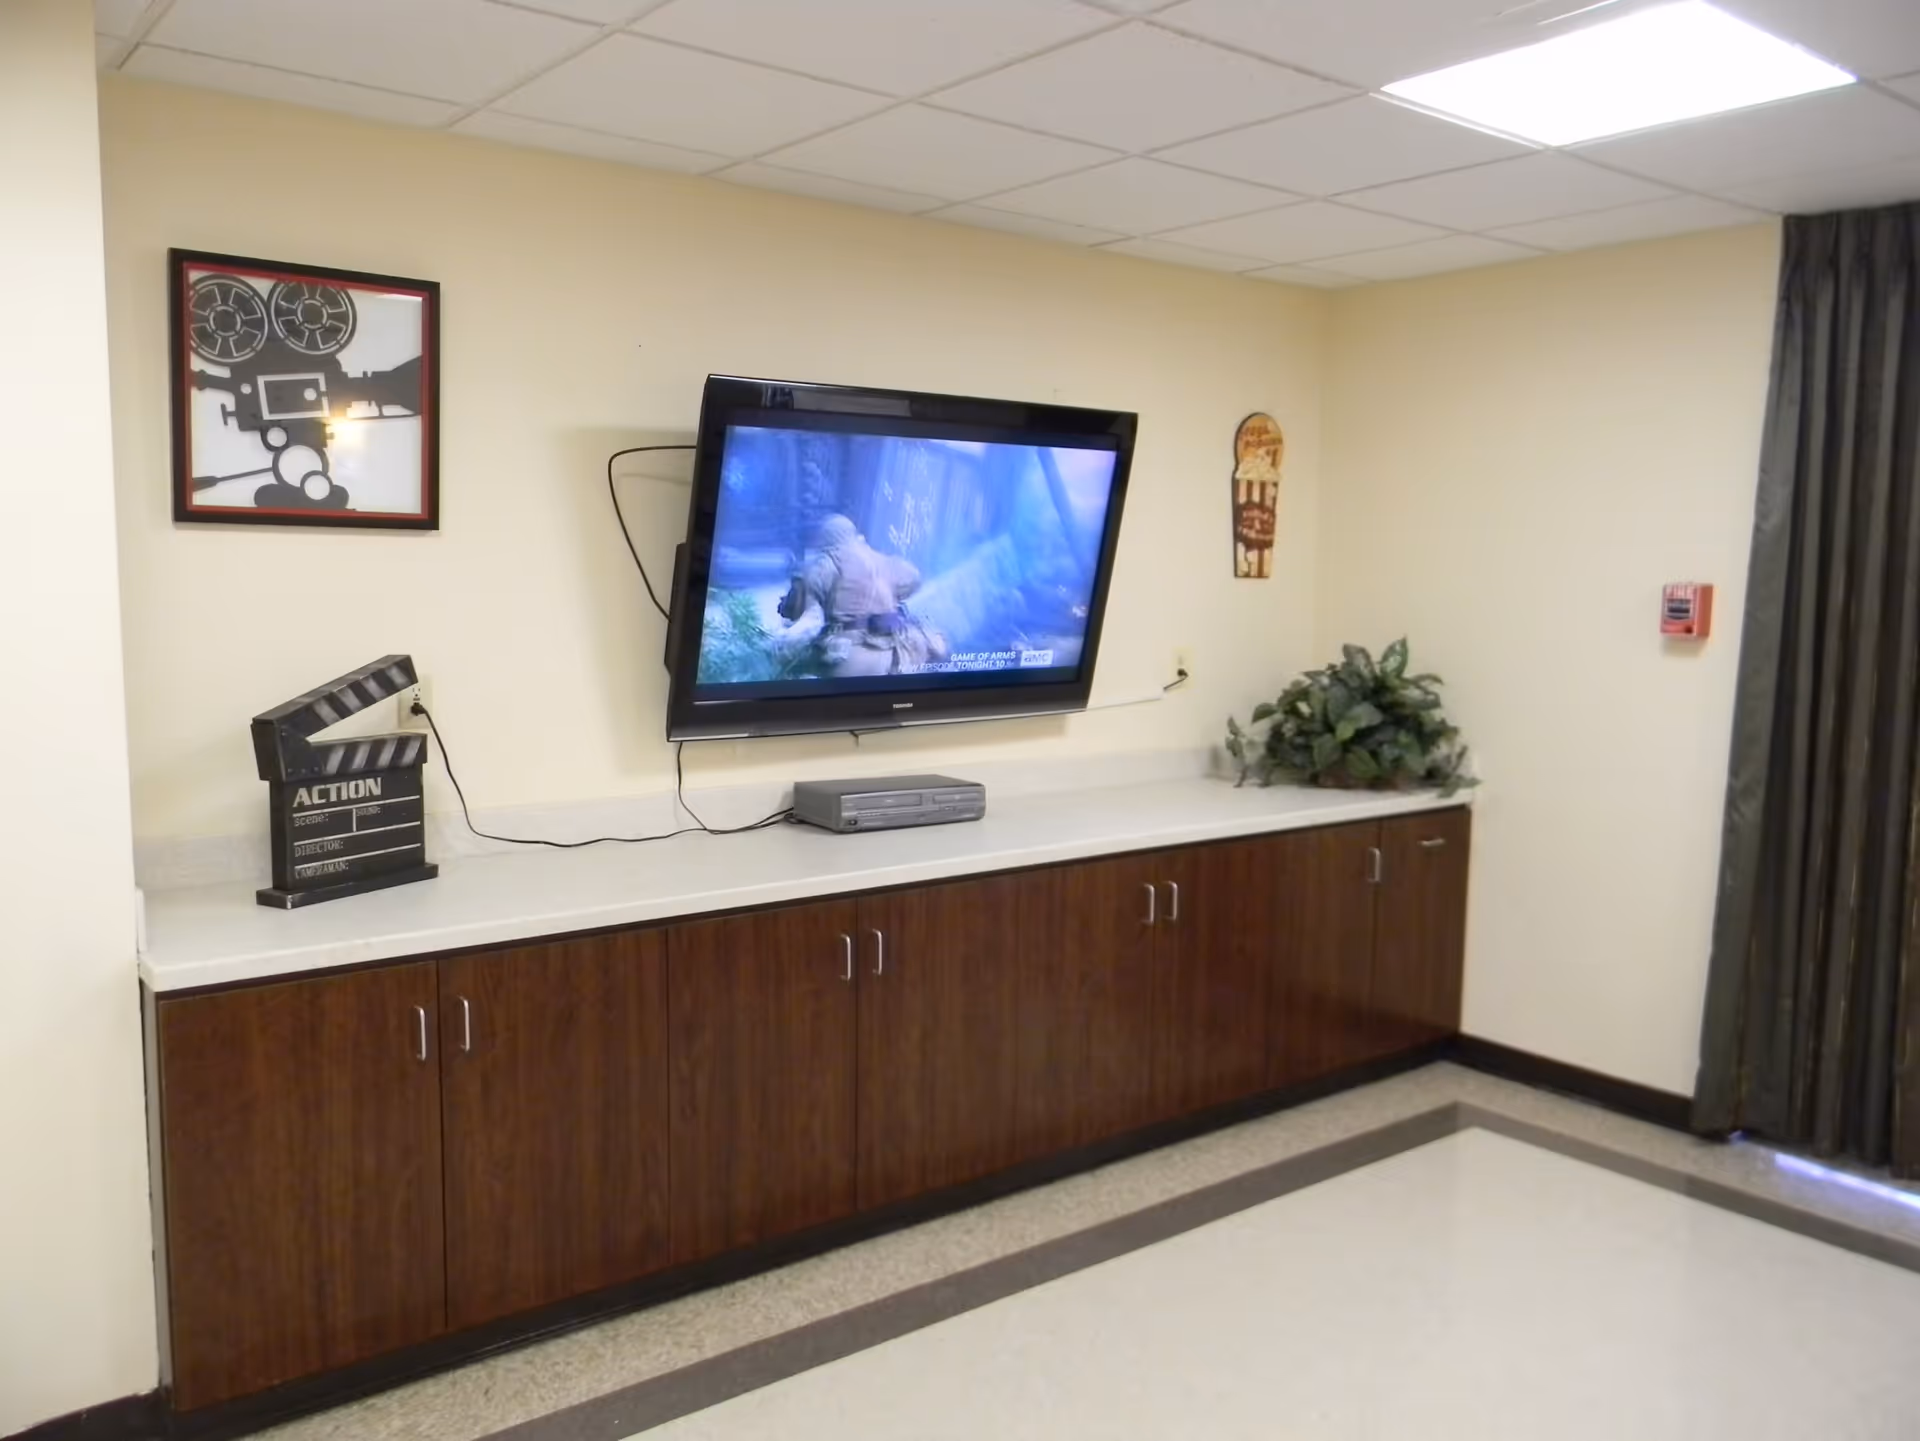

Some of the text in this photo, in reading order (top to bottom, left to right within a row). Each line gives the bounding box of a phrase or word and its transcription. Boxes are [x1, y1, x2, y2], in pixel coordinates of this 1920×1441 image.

[951, 651, 1016, 661] GAME OF ARMS
[957, 660, 994, 669] TONIGHT
[292, 777, 382, 808] ACTION
[294, 840, 344, 858] DIRECTOR:
